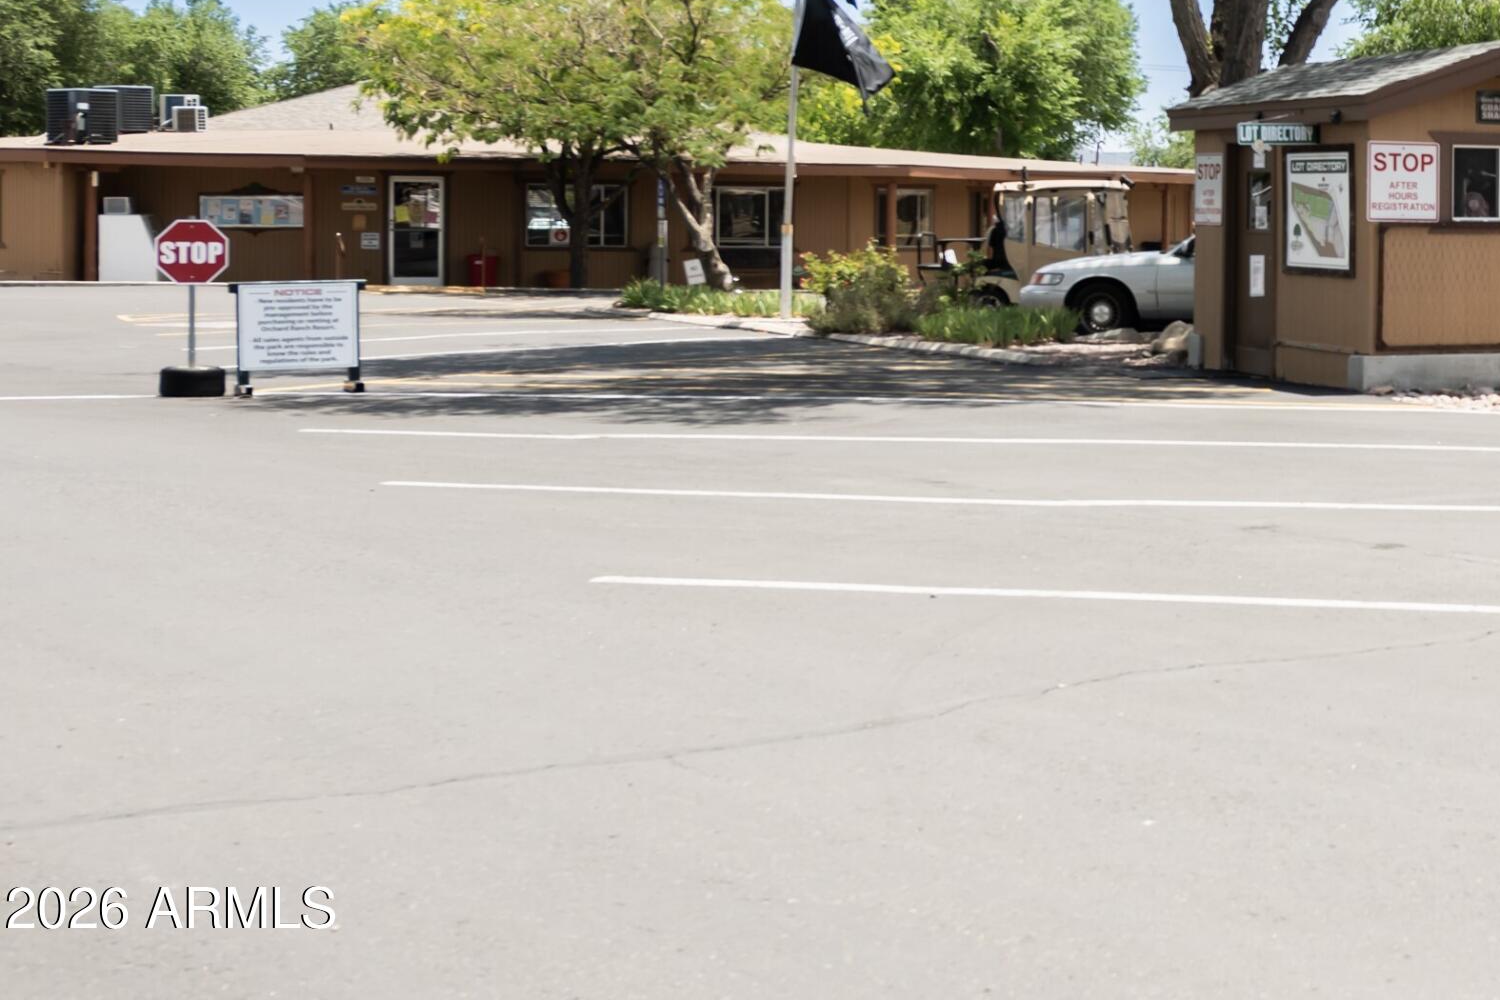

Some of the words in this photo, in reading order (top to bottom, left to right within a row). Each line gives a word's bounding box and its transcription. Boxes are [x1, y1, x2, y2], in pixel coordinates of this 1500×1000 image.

[1240, 125, 1259, 141] LOT
[1261, 125, 1313, 141] DIRECTORY
[1291, 161, 1305, 172] LOT
[1306, 161, 1346, 172] DIRECTORY
[1374, 152, 1434, 172] STOP
[1197, 163, 1221, 180] STOP
[1389, 181, 1418, 189] AFTER
[1388, 192, 1418, 200] HOURS
[1371, 202, 1435, 211] REGISTRATION
[160, 241, 223, 264] STOP
[273, 288, 322, 296] NOTICE
